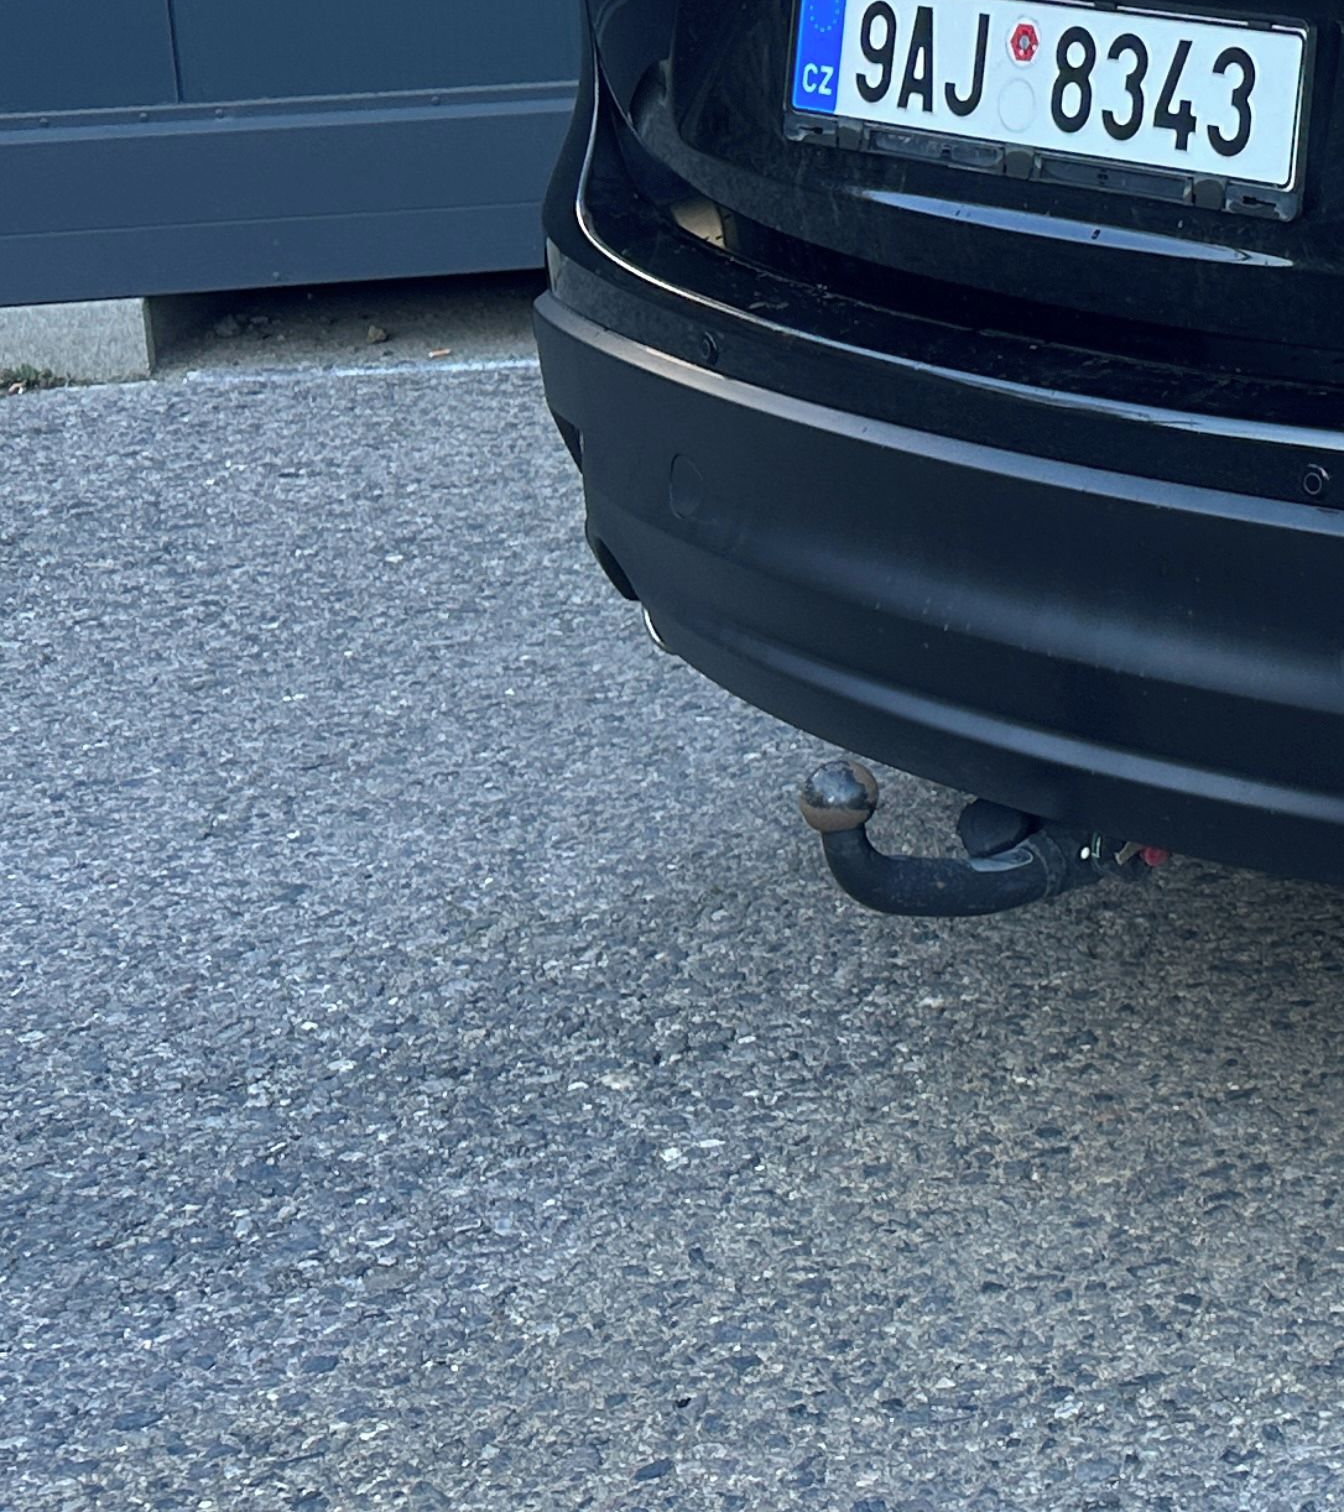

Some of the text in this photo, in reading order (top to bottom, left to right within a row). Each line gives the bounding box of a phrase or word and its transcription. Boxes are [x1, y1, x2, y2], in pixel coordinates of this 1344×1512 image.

[802, 62, 834, 96] CZ
[855, 0, 1257, 158] 9AJ 8343
